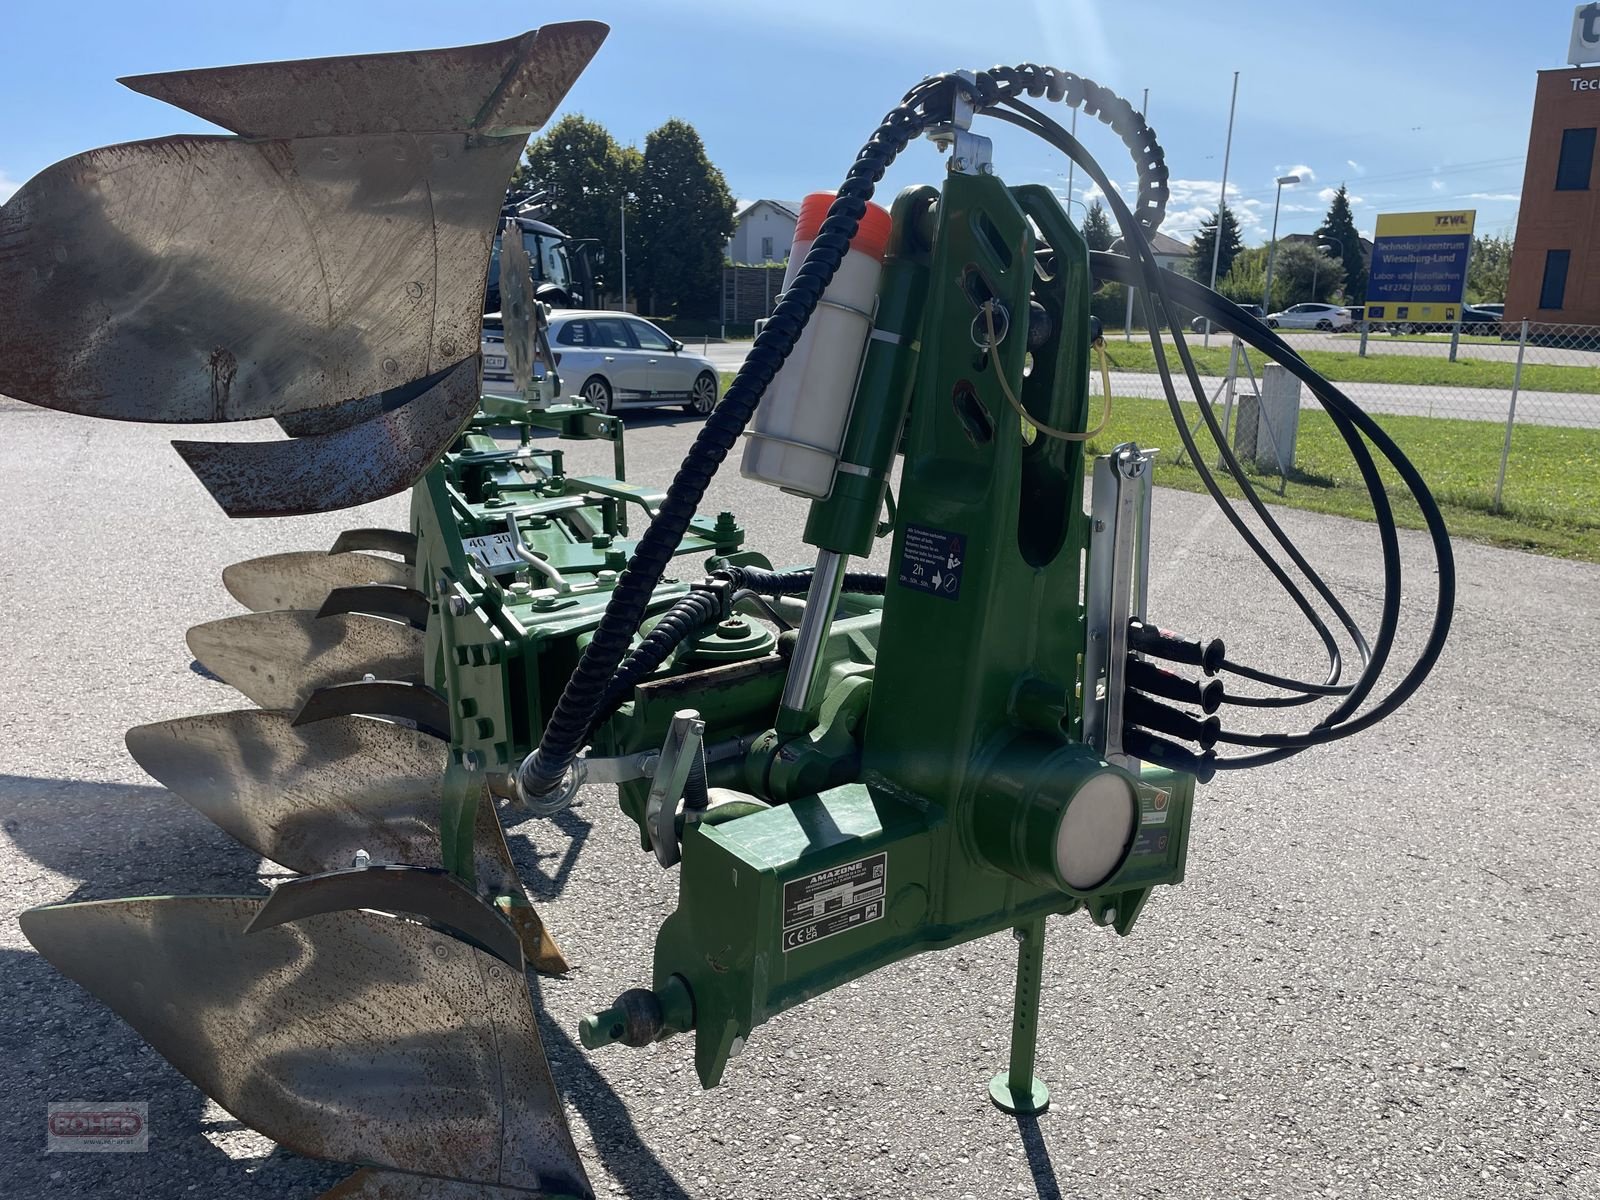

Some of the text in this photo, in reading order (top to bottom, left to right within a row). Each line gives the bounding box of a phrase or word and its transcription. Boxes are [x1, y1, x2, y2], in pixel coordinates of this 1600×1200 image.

[1570, 78, 1600, 91] Tec
[1378, 242, 1464, 252] Technologiezentrum
[1382, 253, 1456, 264] Wieselburg-Land
[1397, 272, 1413, 280] und
[469, 534, 511, 548] 40 30
[912, 563, 924, 576] 2h
[809, 862, 863, 885] AMAZONE
[806, 925, 817, 934] UK
[805, 931, 818, 940] CA
